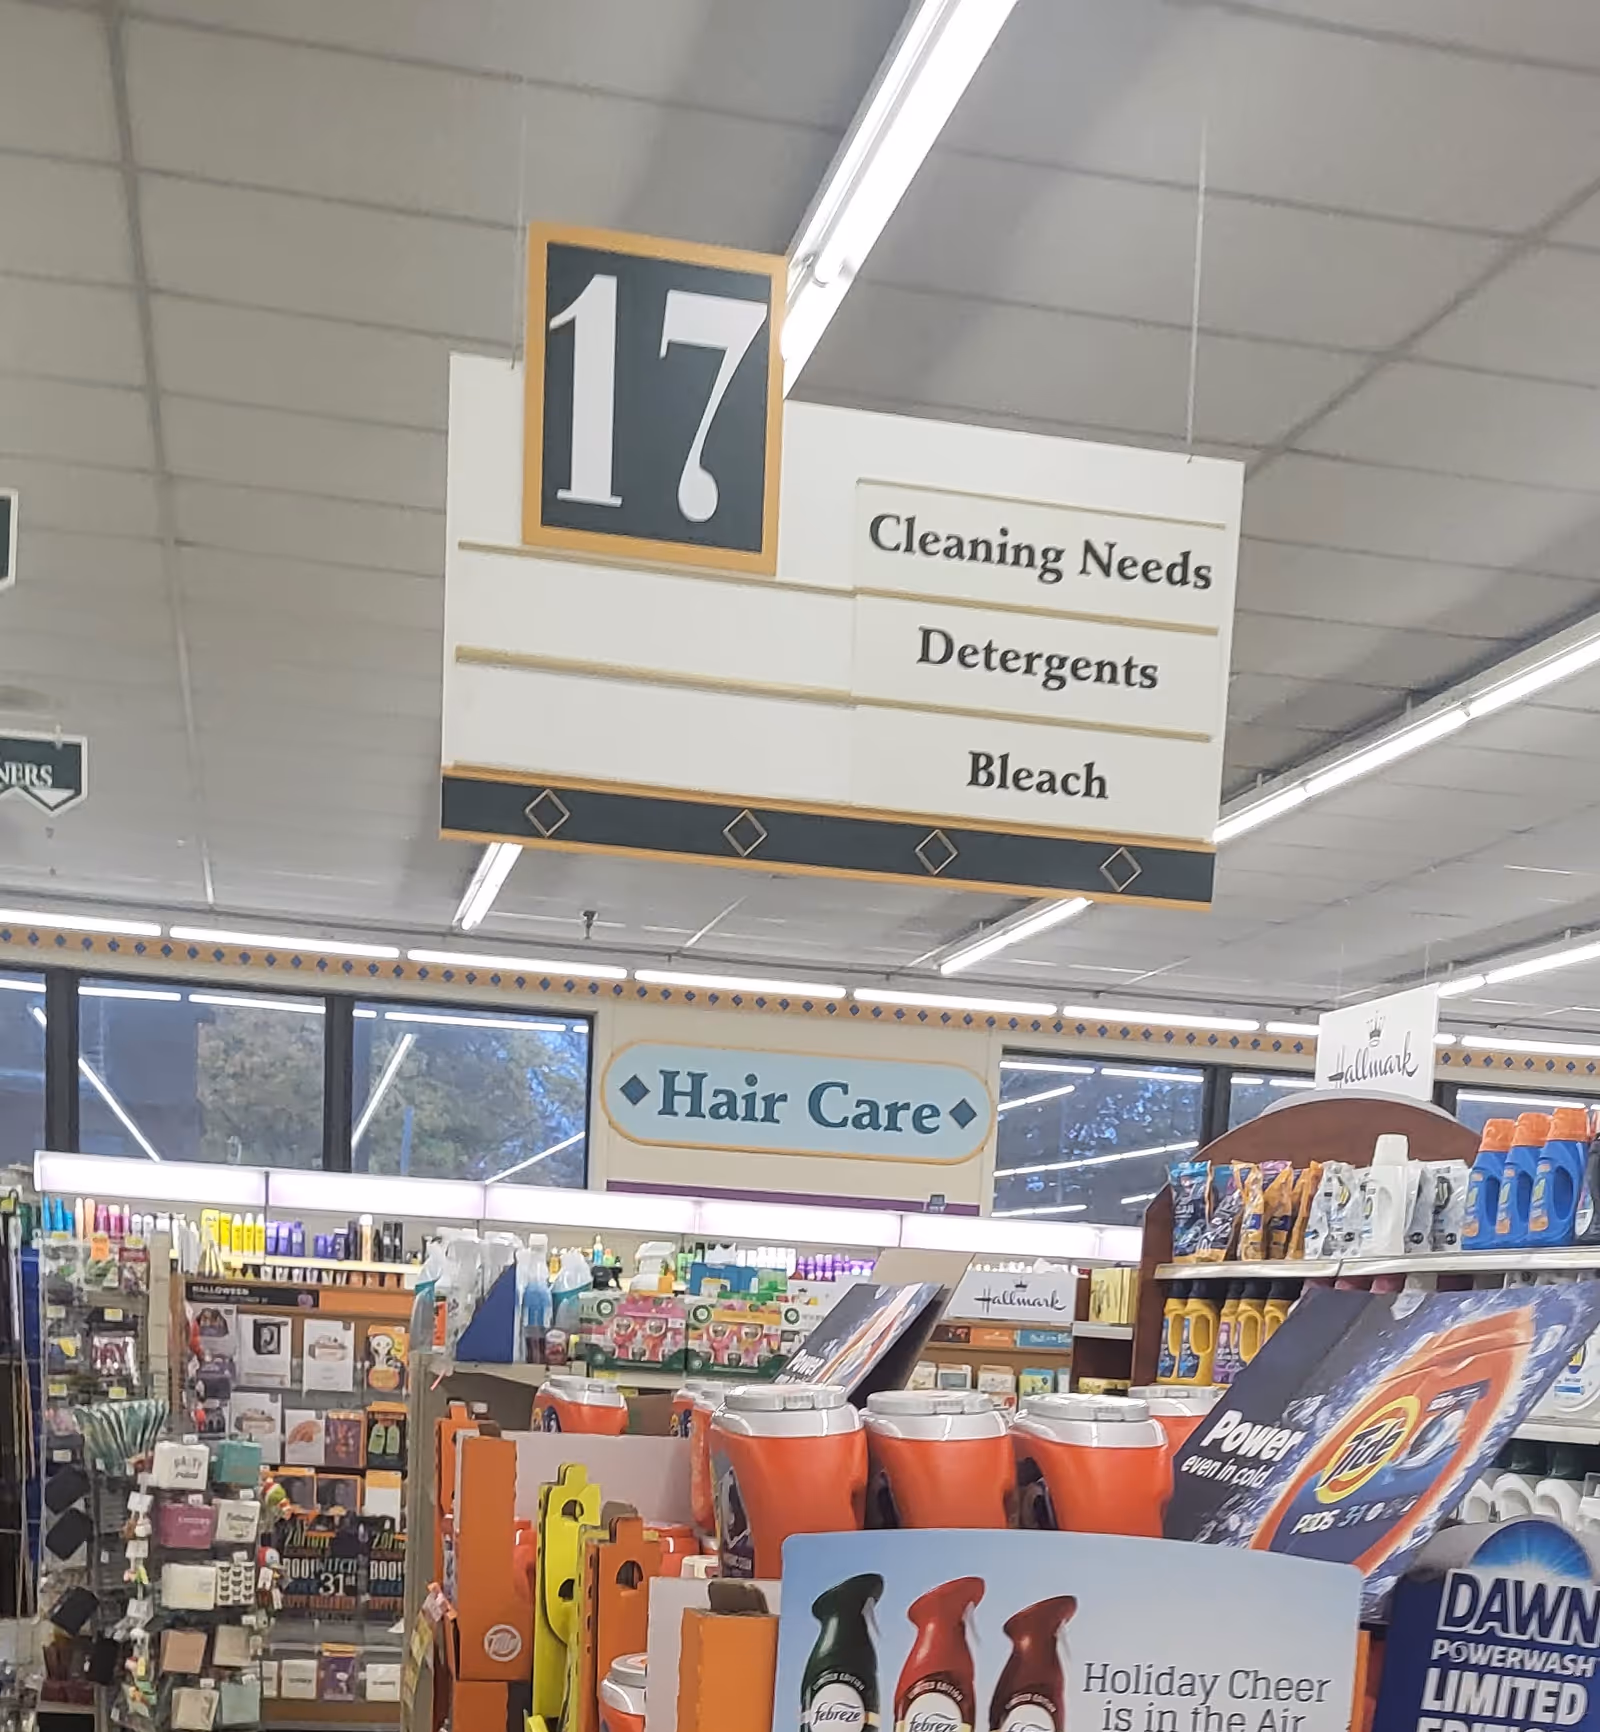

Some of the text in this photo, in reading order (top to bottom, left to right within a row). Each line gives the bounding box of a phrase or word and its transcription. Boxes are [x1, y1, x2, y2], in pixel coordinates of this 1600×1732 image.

[549, 274, 768, 523] 17
[869, 513, 1212, 590] Cleaning Needs
[916, 625, 1160, 691] Detergents
[966, 750, 1109, 799] Bleach
[1327, 1031, 1419, 1088] Hallmark
[657, 1069, 941, 1134] Hair Care
[974, 1285, 1066, 1315] Hallmark
[1200, 1410, 1306, 1462] Power
[1314, 1417, 1407, 1491] Tide
[1181, 1455, 1274, 1488] even in cold.
[1290, 1509, 1340, 1534] PODS
[370, 1560, 401, 1581] BOO!
[1438, 1570, 1600, 1649] DAWN
[1431, 1639, 1596, 1677] POWERWASH
[1082, 1663, 1331, 1706] Holiday Cheer
[1421, 1667, 1588, 1725] LIMITED
[813, 1702, 862, 1725] febreze
[1102, 1700, 1133, 1732] is
